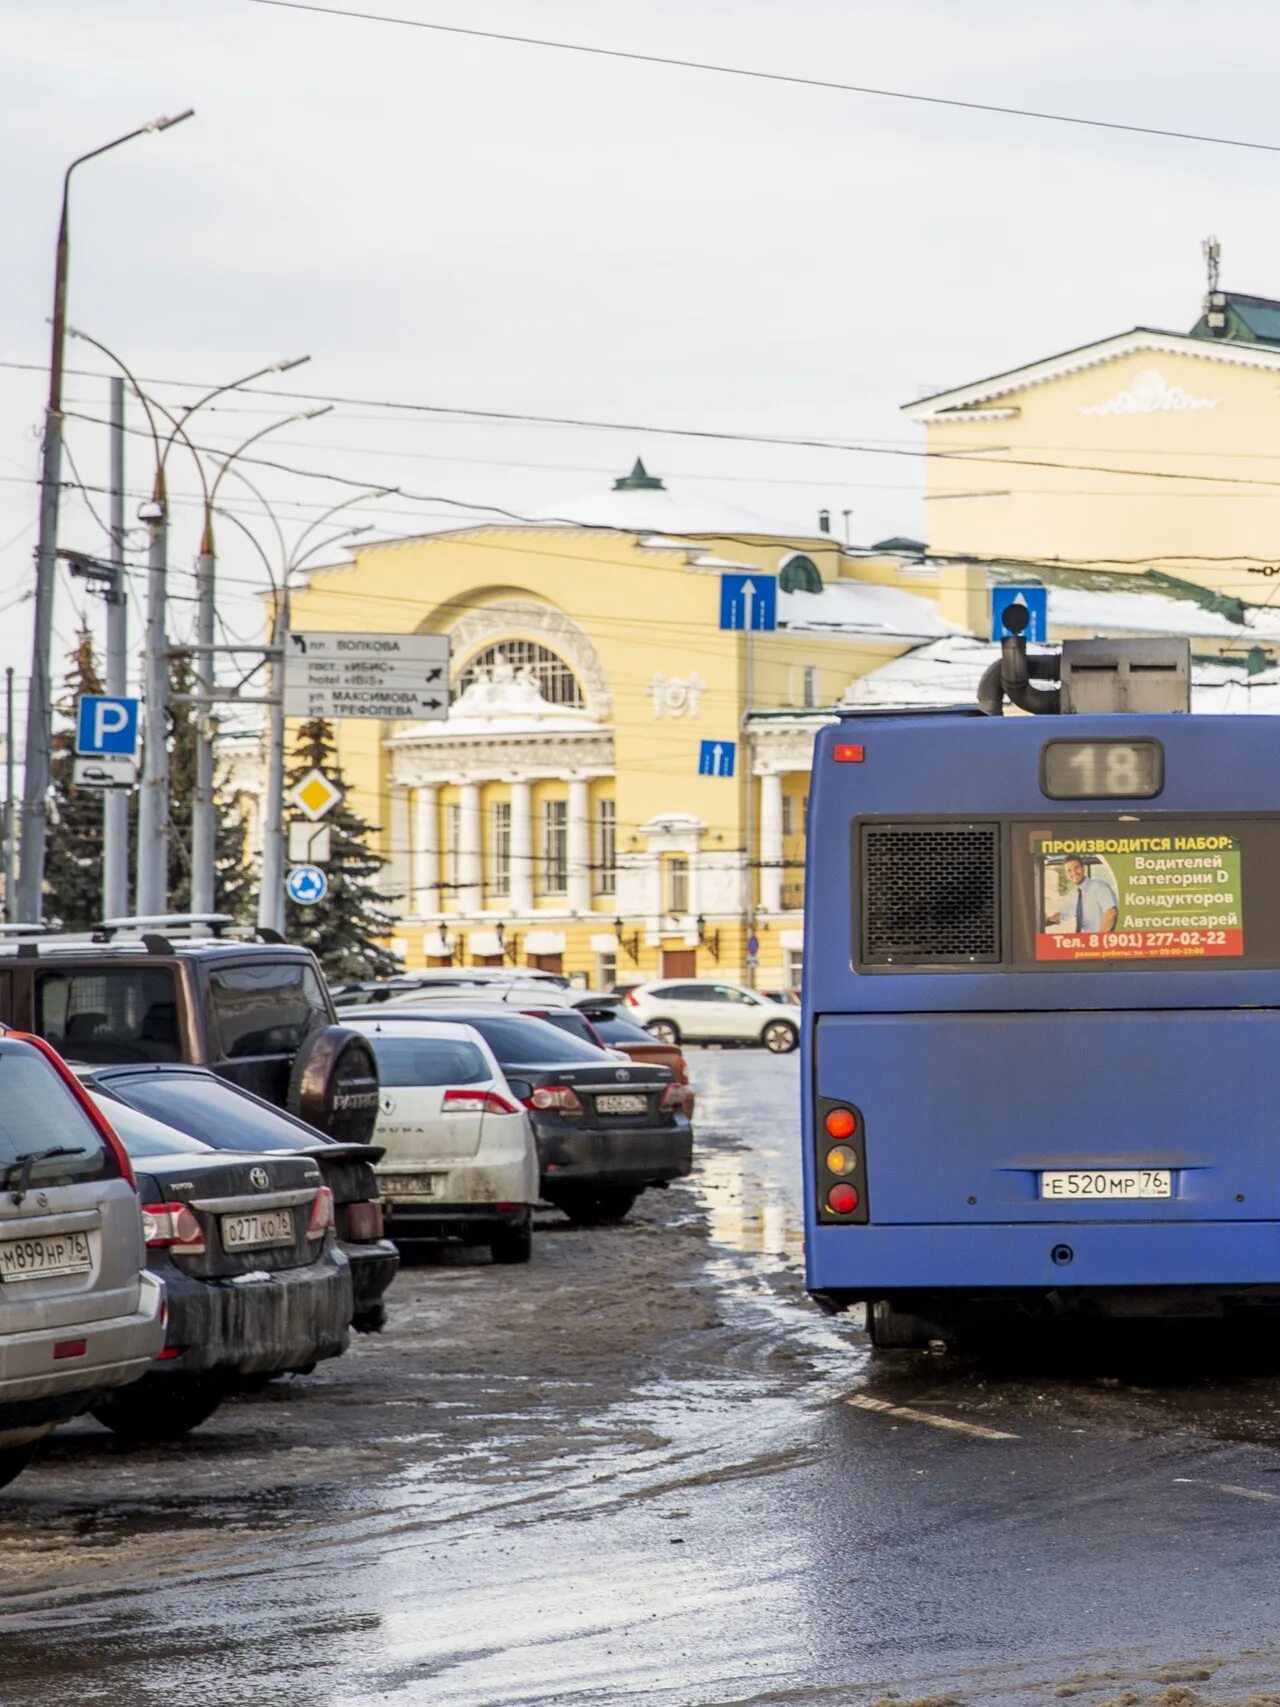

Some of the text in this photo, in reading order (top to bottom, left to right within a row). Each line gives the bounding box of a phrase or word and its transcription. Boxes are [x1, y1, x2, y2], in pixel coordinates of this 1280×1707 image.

[337, 640, 400, 651] ВОЛКОВА
[308, 674, 339, 684] hotel
[332, 691, 418, 703] МАКСИМОВА
[333, 704, 413, 716] ТРЕФОЛЕВА
[93, 701, 129, 748] P
[1070, 744, 1139, 794] 18
[1041, 836, 1233, 854] ПРОИЗВОДИТСЯ НАБОР:
[1134, 854, 1223, 870] Водителей
[1129, 870, 1229, 887] категории D
[1124, 892, 1234, 908] Кондукторов
[1123, 912, 1237, 928] Автослесарей
[1053, 931, 1226, 949] Тел. 8 (901) 277-02-22
[1142, 1172, 1162, 1188] 76
[276, 1212, 288, 1230] 76
[66, 1235, 83, 1259] 76
